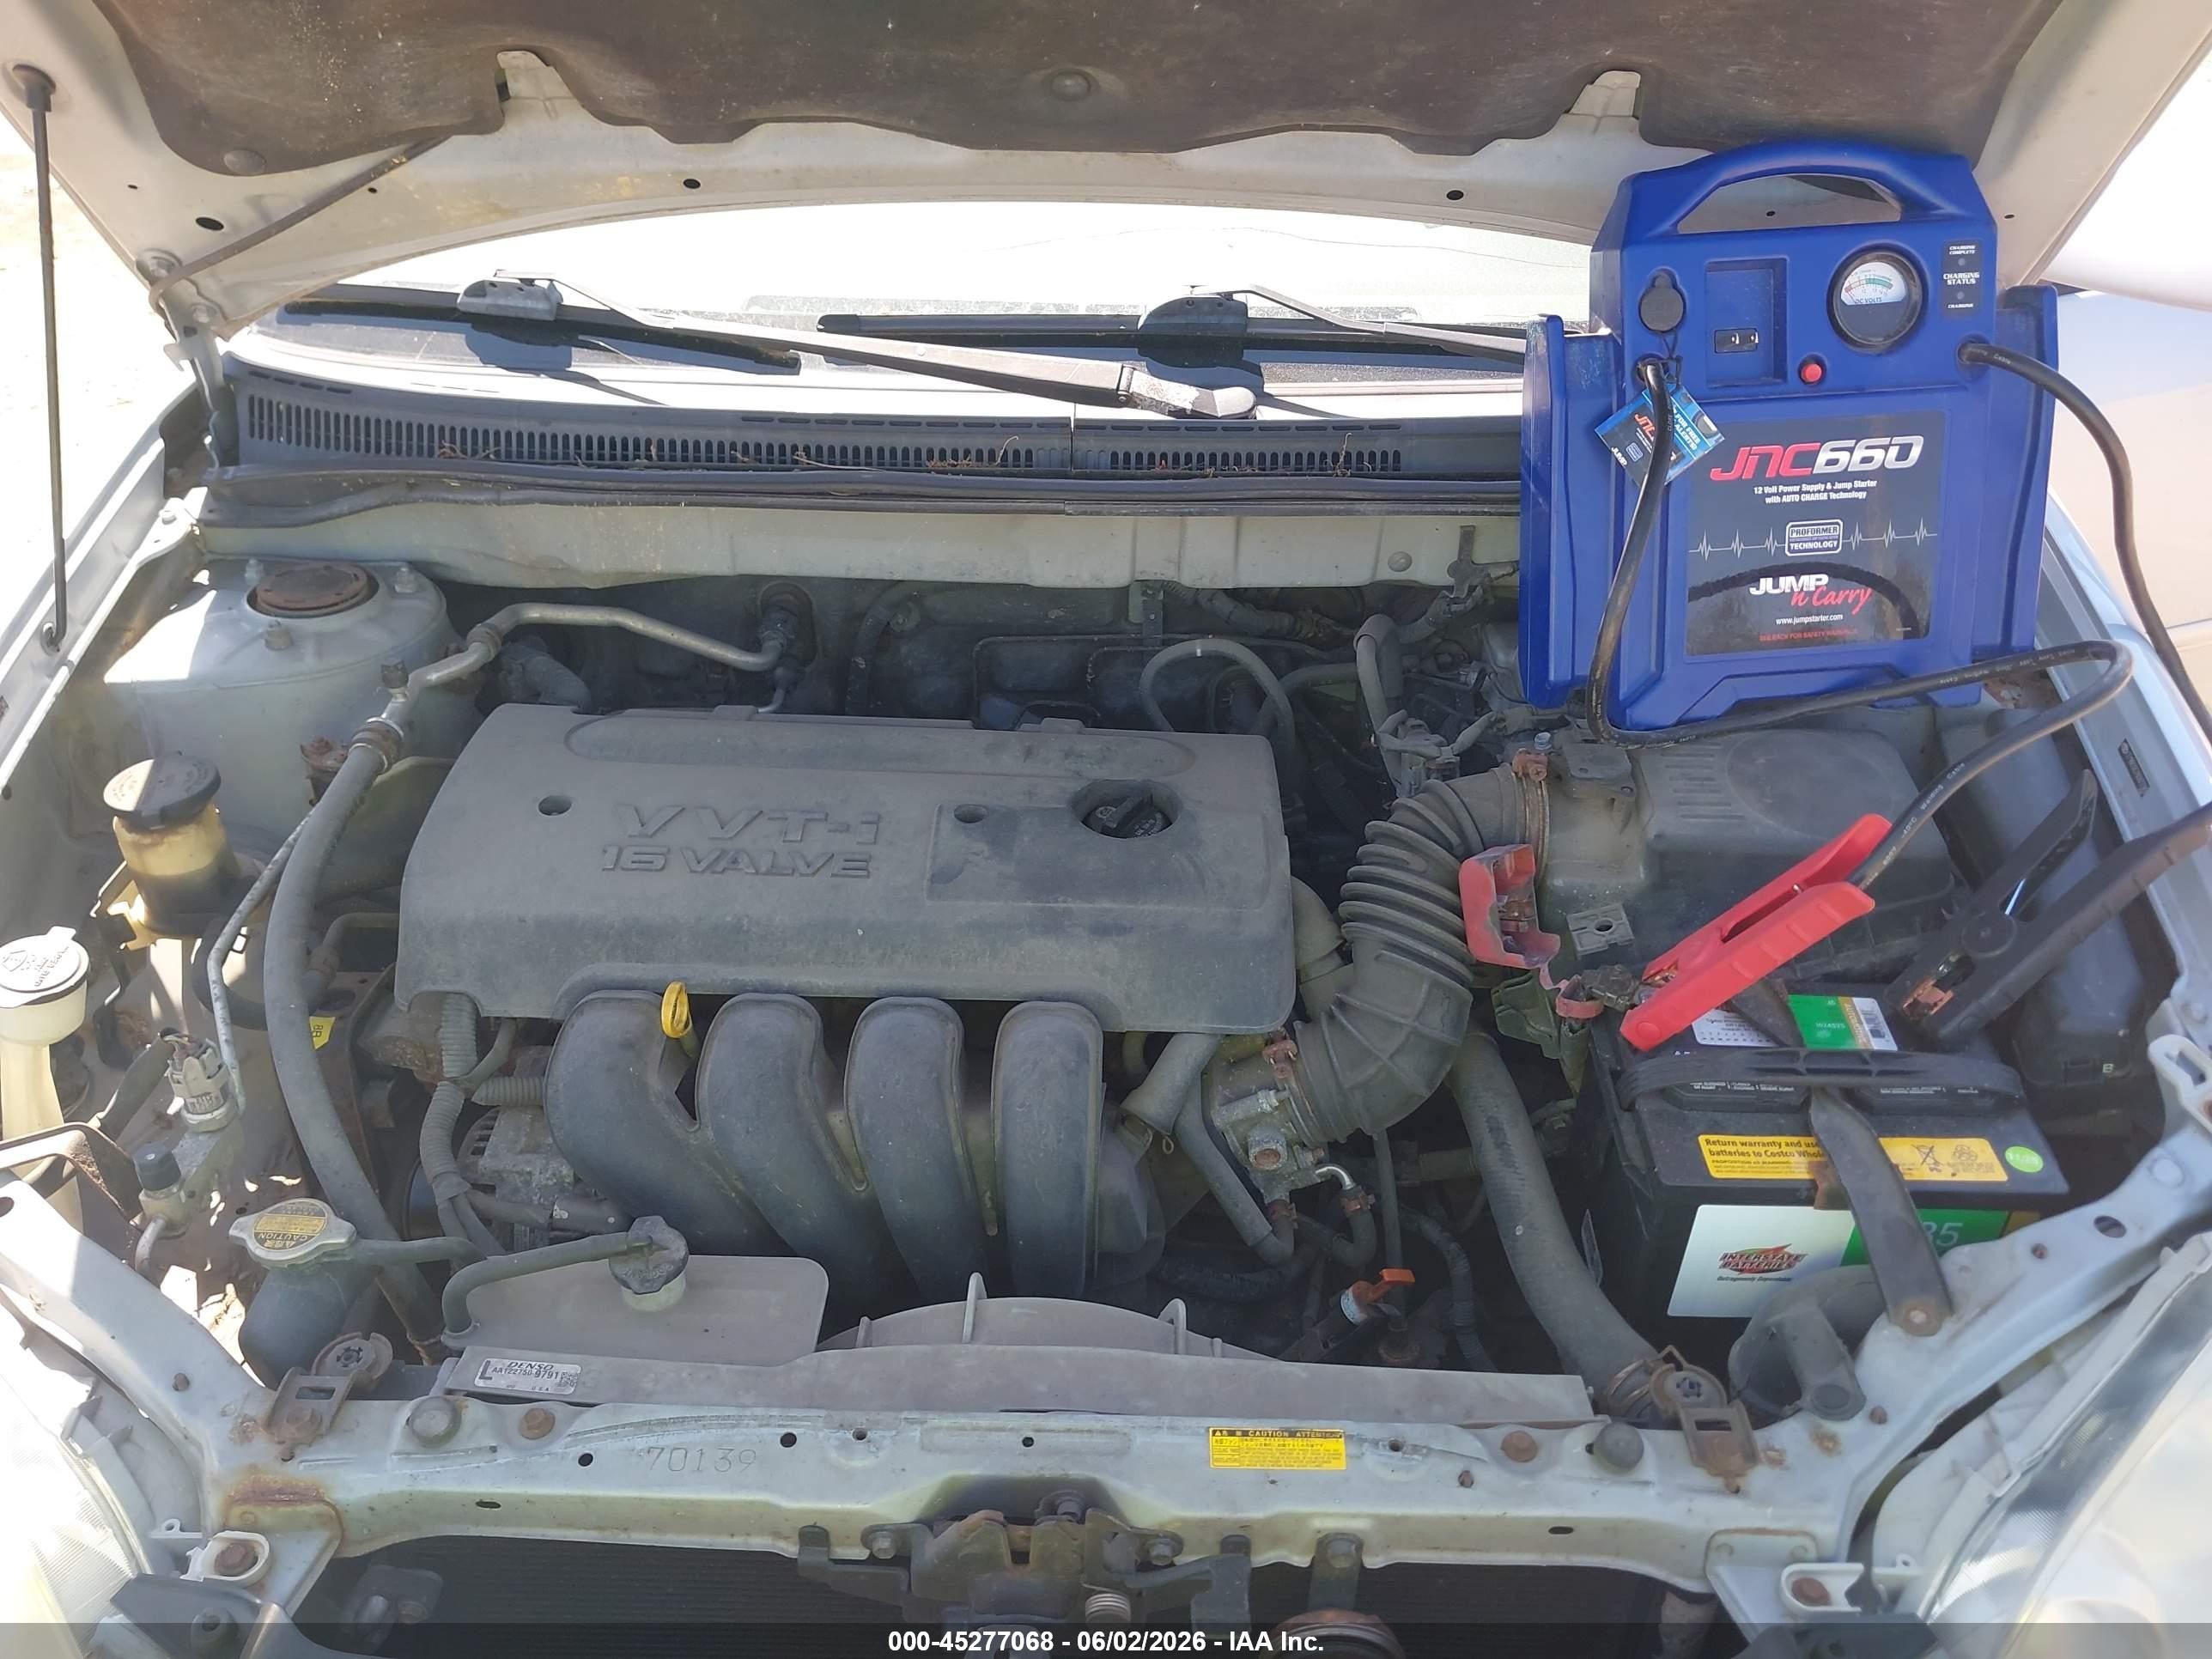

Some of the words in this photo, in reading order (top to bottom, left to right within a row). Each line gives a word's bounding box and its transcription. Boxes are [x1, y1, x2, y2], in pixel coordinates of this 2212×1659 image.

[1686, 426, 1701, 443] FREE
[1611, 447, 1628, 466] JUMP
[1710, 434, 1924, 482] JNC660
[1764, 484, 1778, 495] Volt
[1778, 483, 1800, 494] Power
[1802, 483, 1825, 493] Supply
[1833, 481, 1852, 491] Jump
[1854, 479, 1878, 489] Starter
[1765, 495, 1781, 504] with
[1782, 493, 1800, 502] AUTO
[1802, 491, 1828, 501] CHARGE
[1830, 489, 1867, 501] Technology
[1790, 526, 1838, 536] PROFORMER
[1790, 541, 1838, 550] TECHNOLOGY
[1749, 574, 1829, 595] JUMP
[1791, 590, 1807, 606] n
[1812, 586, 1873, 616] Carry
[1776, 614, 1844, 625] www.jumpstarter.com
[1920, 784, 1943, 810] Welding
[1947, 763, 1965, 779] Cable
[602, 844, 670, 872] 16
[680, 846, 872, 878] VALVE
[1705, 1138, 1738, 1146] Return
[1741, 1139, 1782, 1149] warranty
[1785, 1139, 1802, 1148] and
[1710, 1149, 1751, 1158] batteries
[259, 1232, 307, 1242] CAUTION
[1718, 1253, 1804, 1261] INTERSTATE
[479, 1360, 493, 1380] L
[507, 1361, 554, 1370] DENSO
[647, 1446, 757, 1474] 70139
